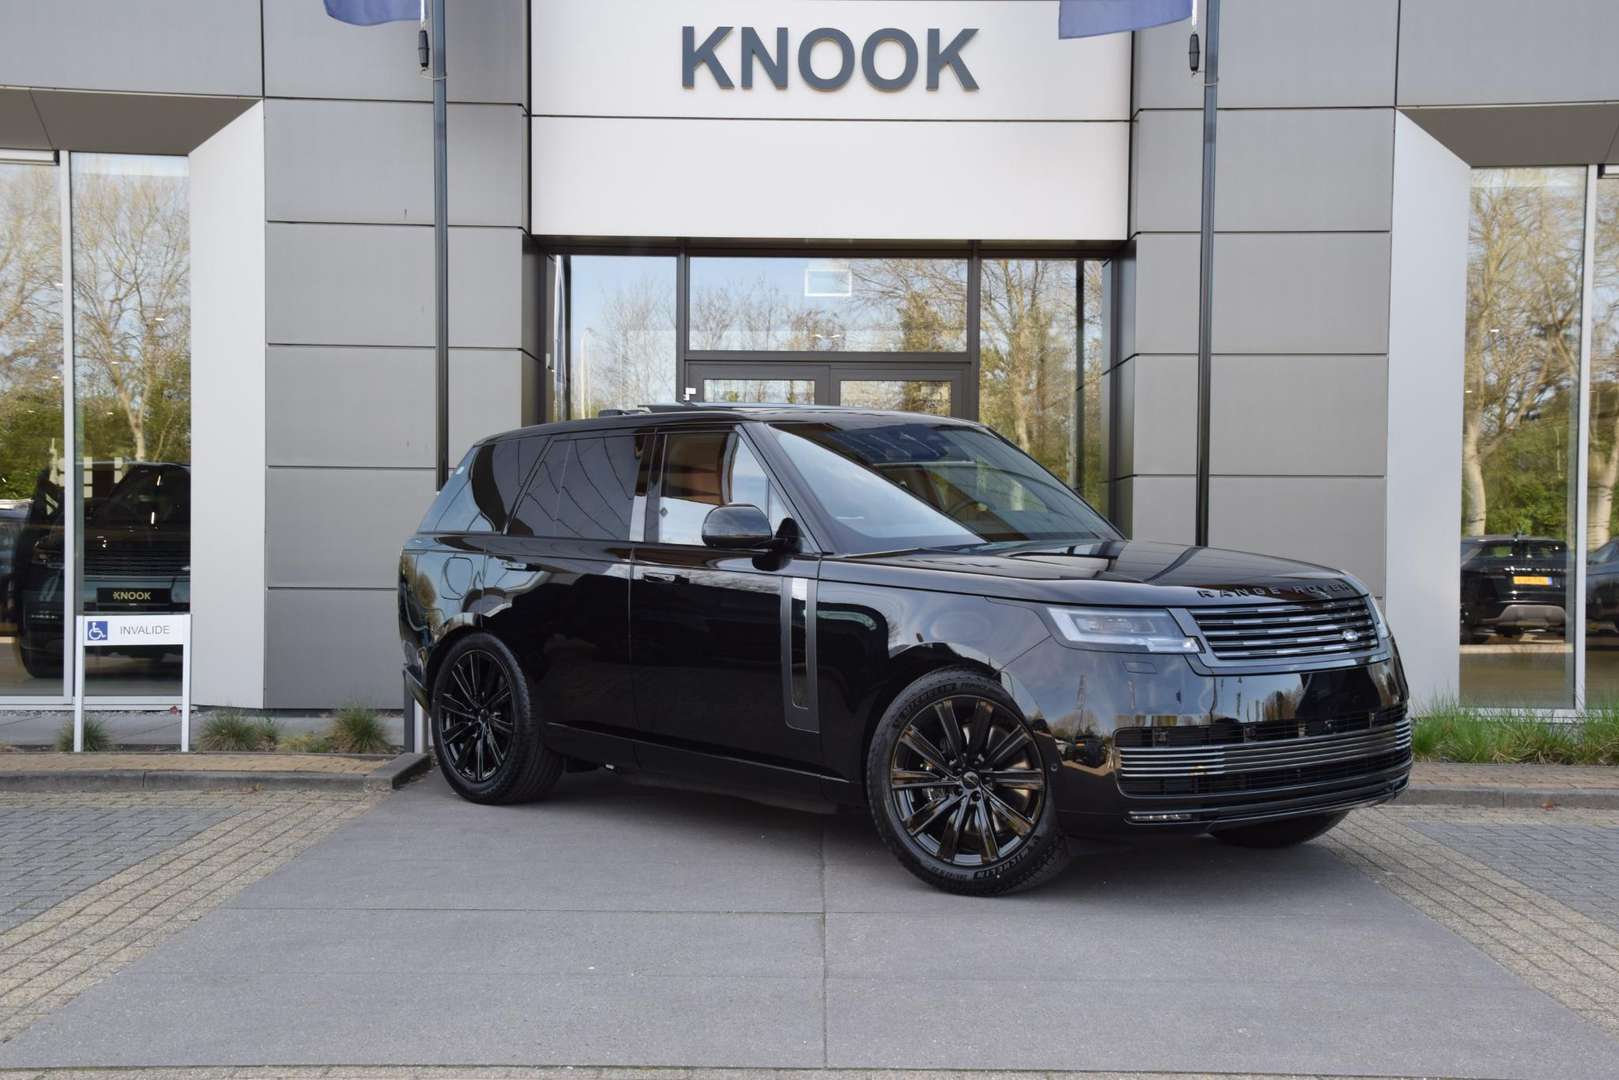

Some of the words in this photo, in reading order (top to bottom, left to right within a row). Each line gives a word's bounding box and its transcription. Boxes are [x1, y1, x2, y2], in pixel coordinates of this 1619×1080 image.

[681, 26, 980, 92] KNOOK
[113, 591, 151, 600] KNOOK
[1196, 585, 1281, 598] RANGE
[119, 624, 170, 635] INVALIDE
